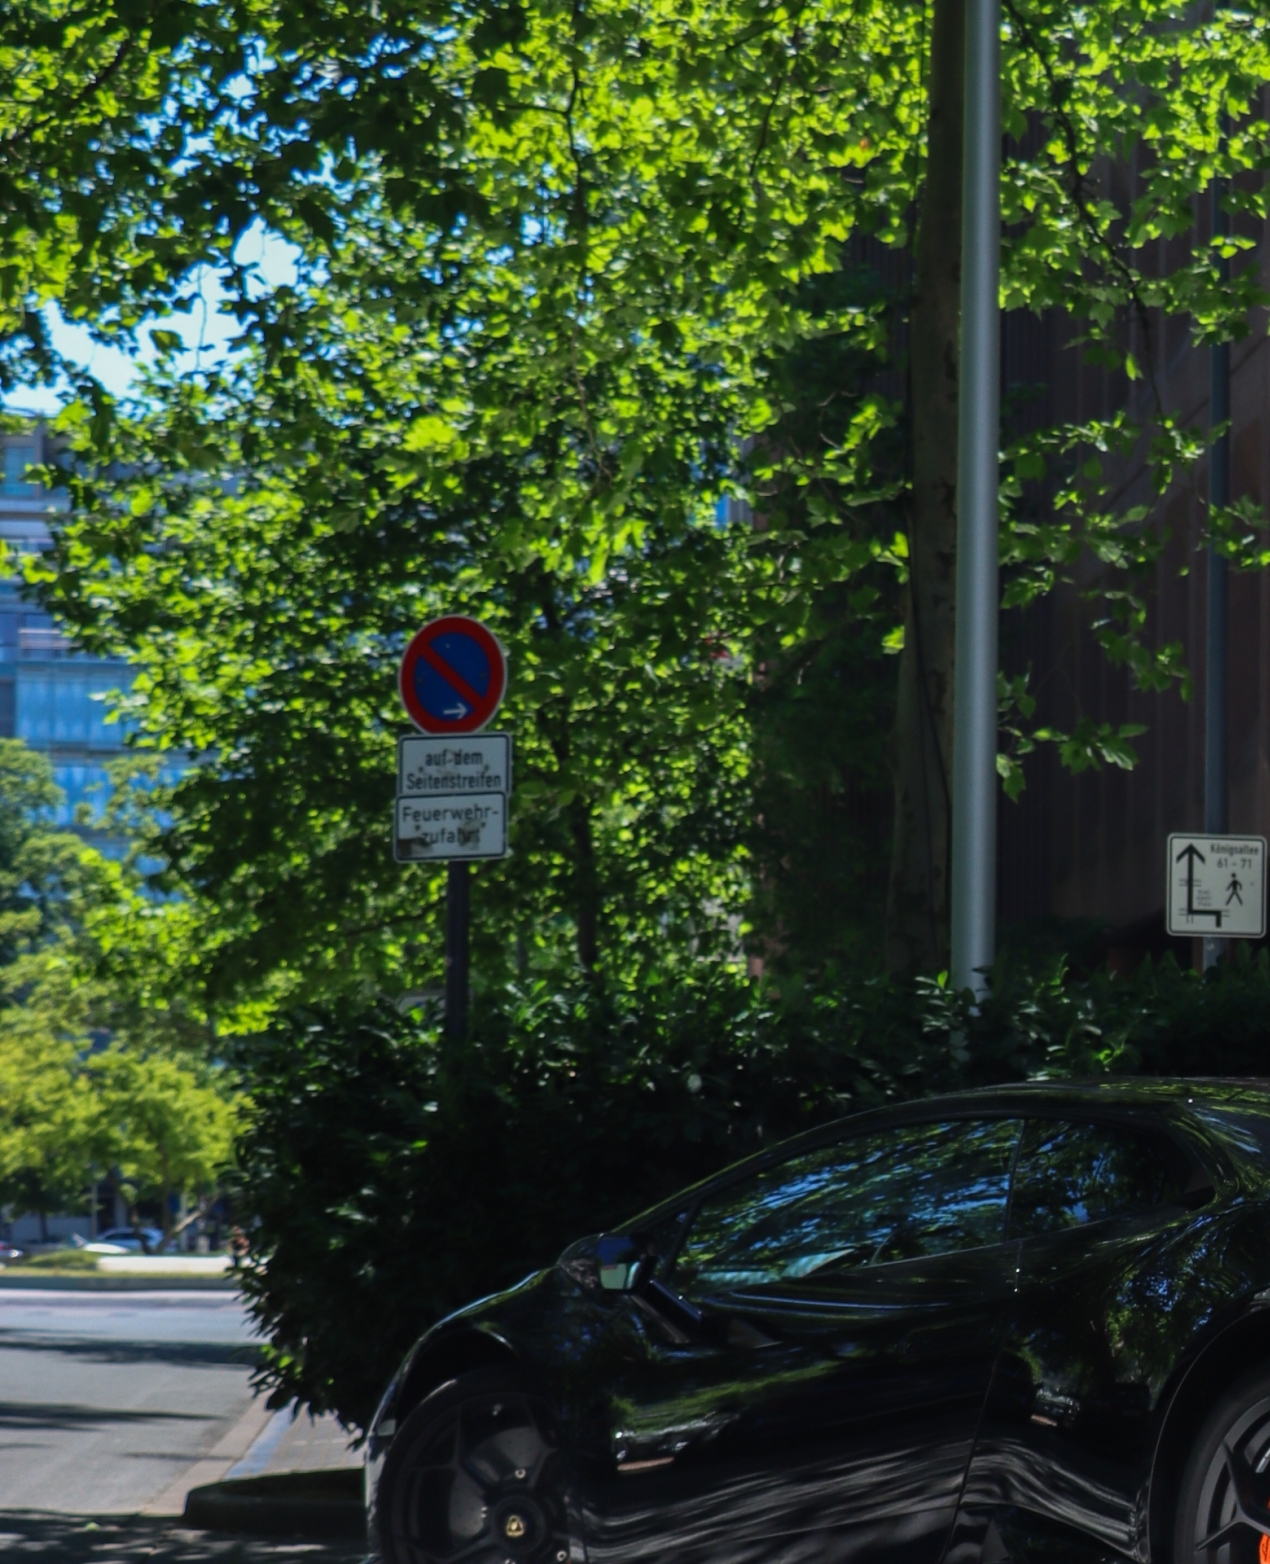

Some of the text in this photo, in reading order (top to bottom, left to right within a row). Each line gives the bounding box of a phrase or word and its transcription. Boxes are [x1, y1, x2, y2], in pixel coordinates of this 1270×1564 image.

[425, 749, 447, 766] auf
[406, 771, 501, 790] Seitenstreifen
[402, 803, 499, 821] Feuerwehr-
[1210, 844, 1259, 856] Königsallee
[1217, 857, 1228, 868] 61
[1240, 858, 1252, 869] 71
